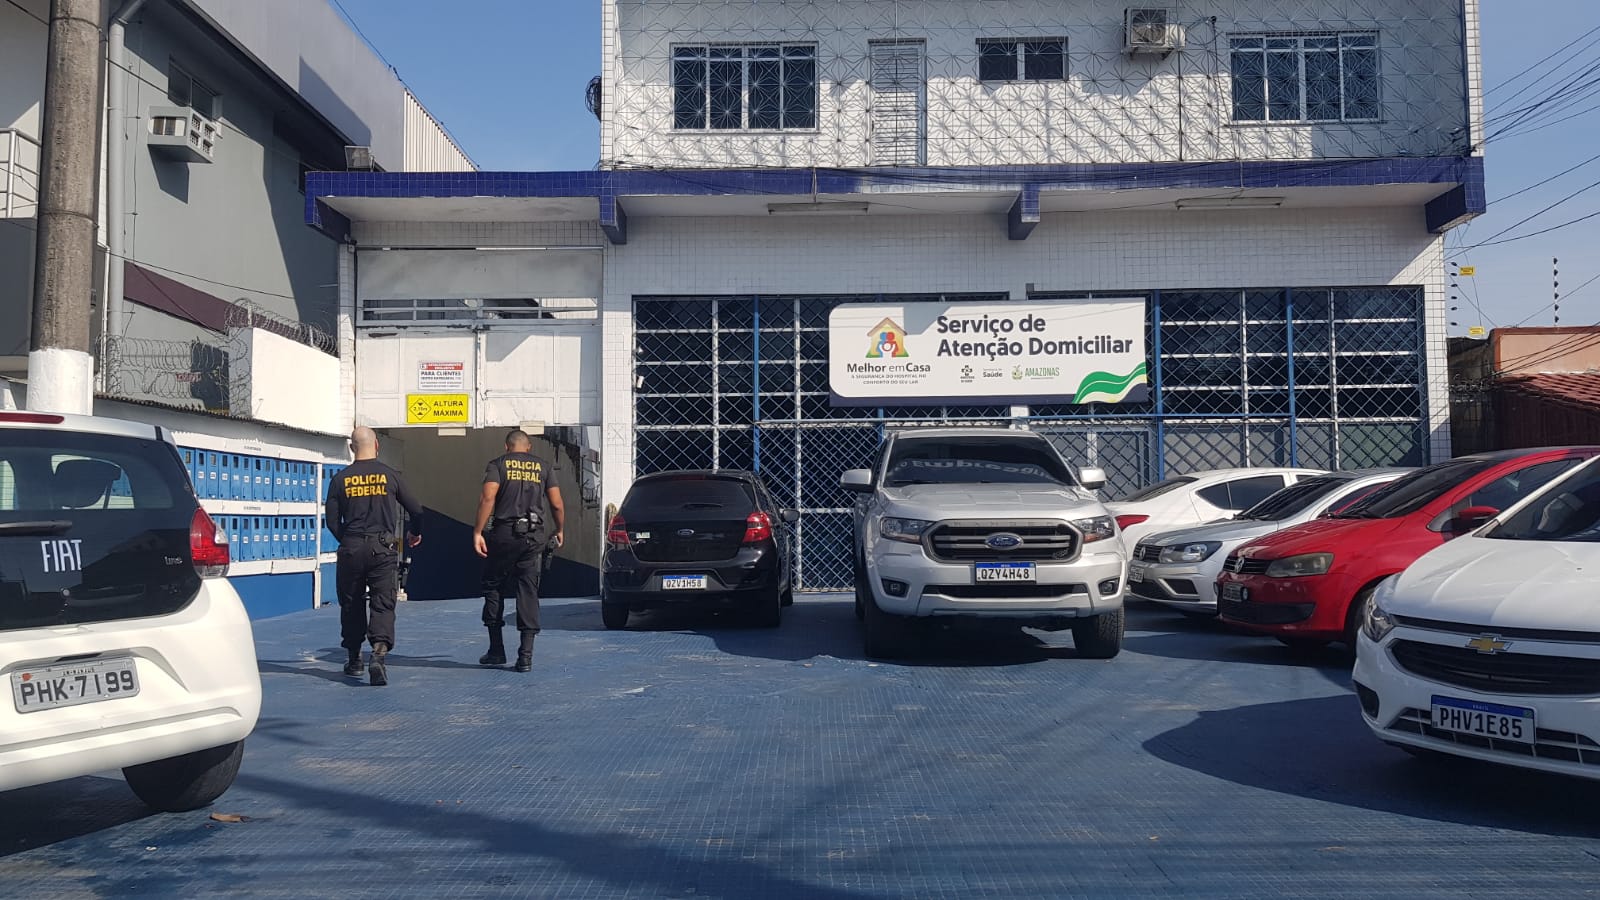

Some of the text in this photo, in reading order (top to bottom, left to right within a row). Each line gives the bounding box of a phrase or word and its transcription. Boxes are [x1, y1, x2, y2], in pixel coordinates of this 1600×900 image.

[936, 314, 1046, 338] Serviço de
[937, 335, 1133, 361] Atenção Domiciliar
[847, 362, 886, 373] Melhor
[1025, 367, 1060, 377] AMAZONAS
[433, 409, 464, 417] MÁXIMA
[344, 473, 388, 487] POLICIA
[506, 470, 542, 483] FEDERAL
[345, 485, 388, 498] FEDERAL
[40, 539, 82, 573] FIAT
[981, 568, 1030, 580] QZY4H48
[1440, 707, 1522, 738] PHV1E85
